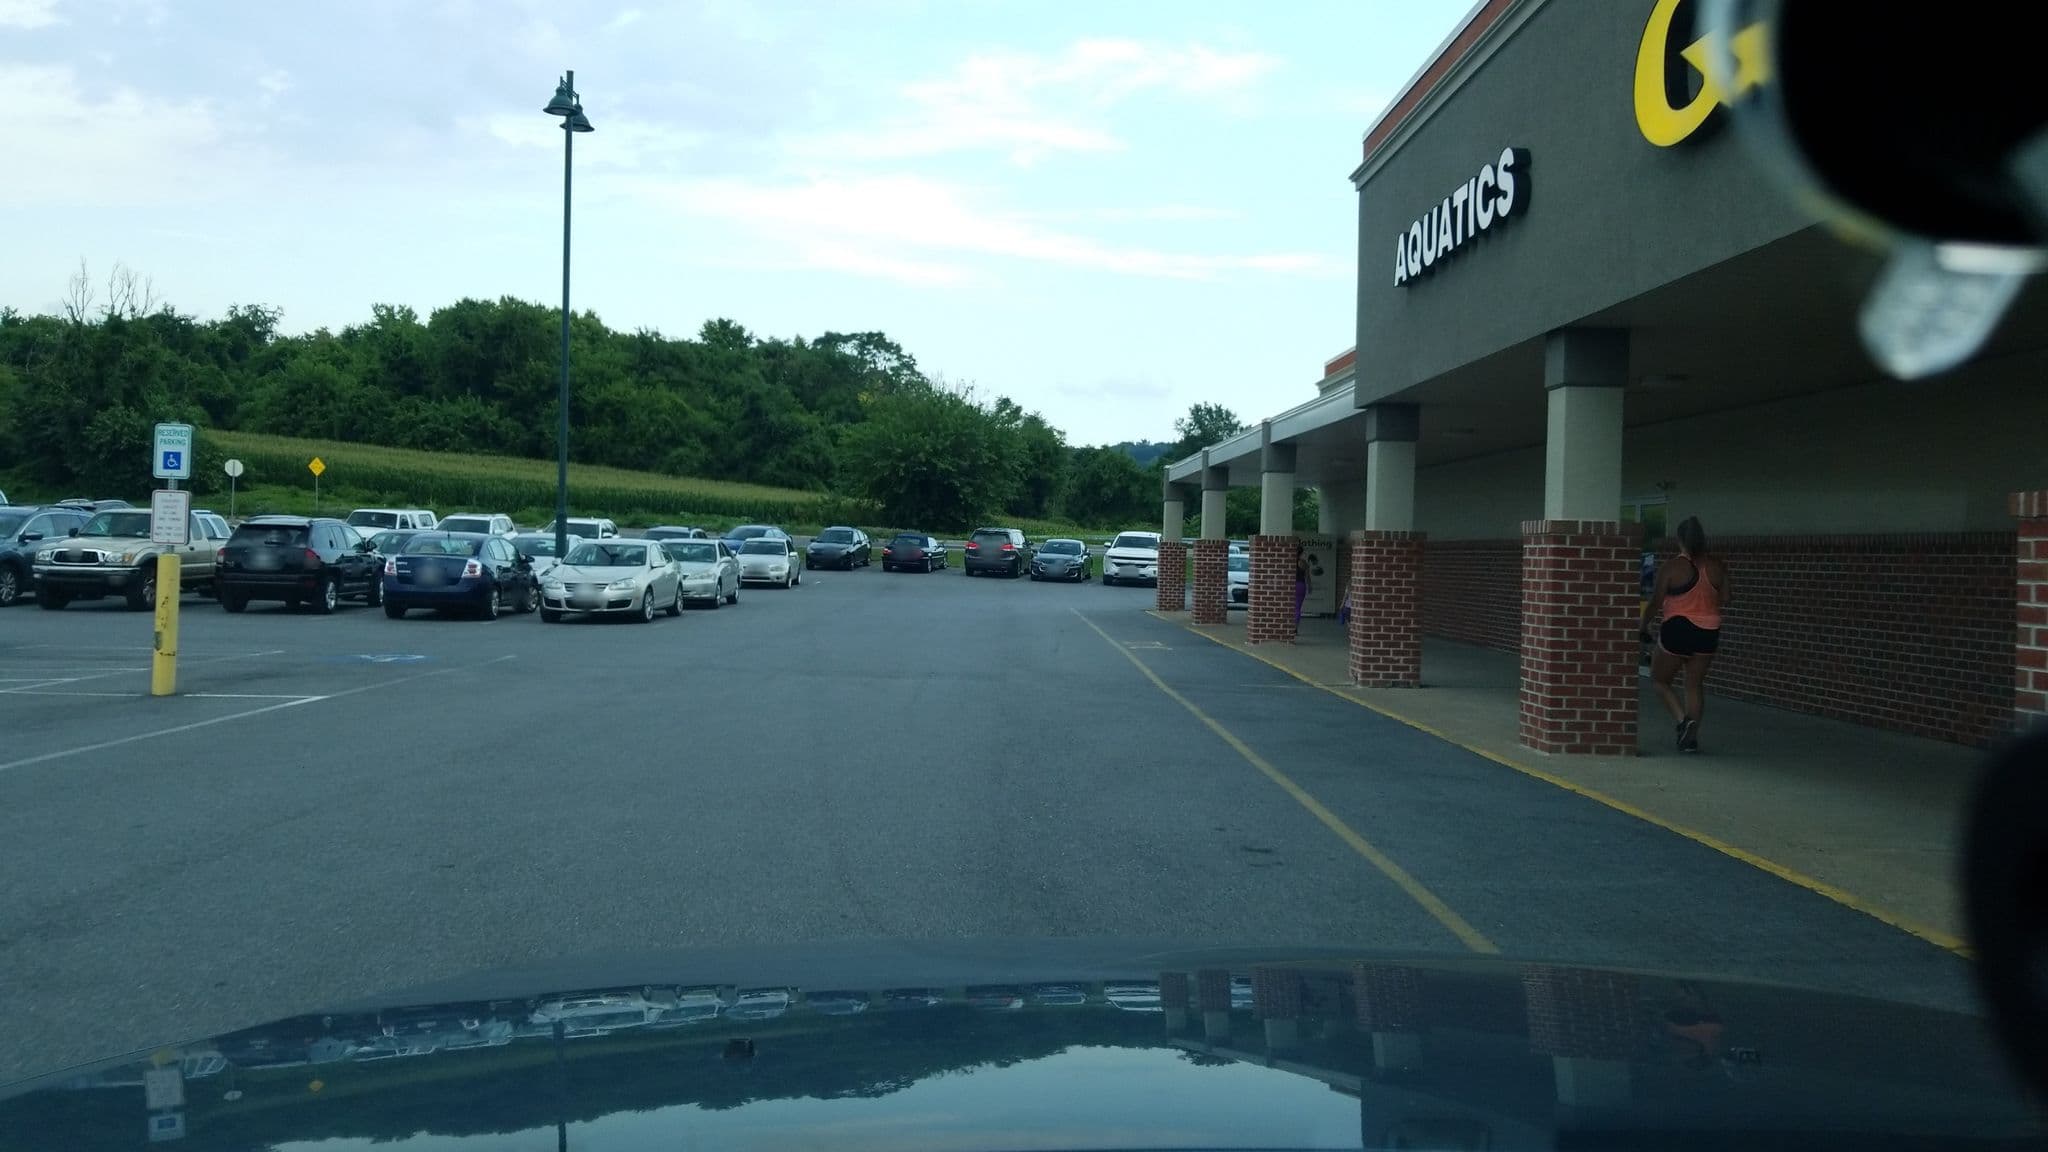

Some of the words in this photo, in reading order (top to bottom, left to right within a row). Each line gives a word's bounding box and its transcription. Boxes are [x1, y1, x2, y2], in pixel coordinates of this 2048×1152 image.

[1394, 147, 1515, 286] AQUATICS
[159, 429, 189, 438] RESERVED
[160, 438, 186, 446] PARKING
[1298, 538, 1332, 549] lothing
